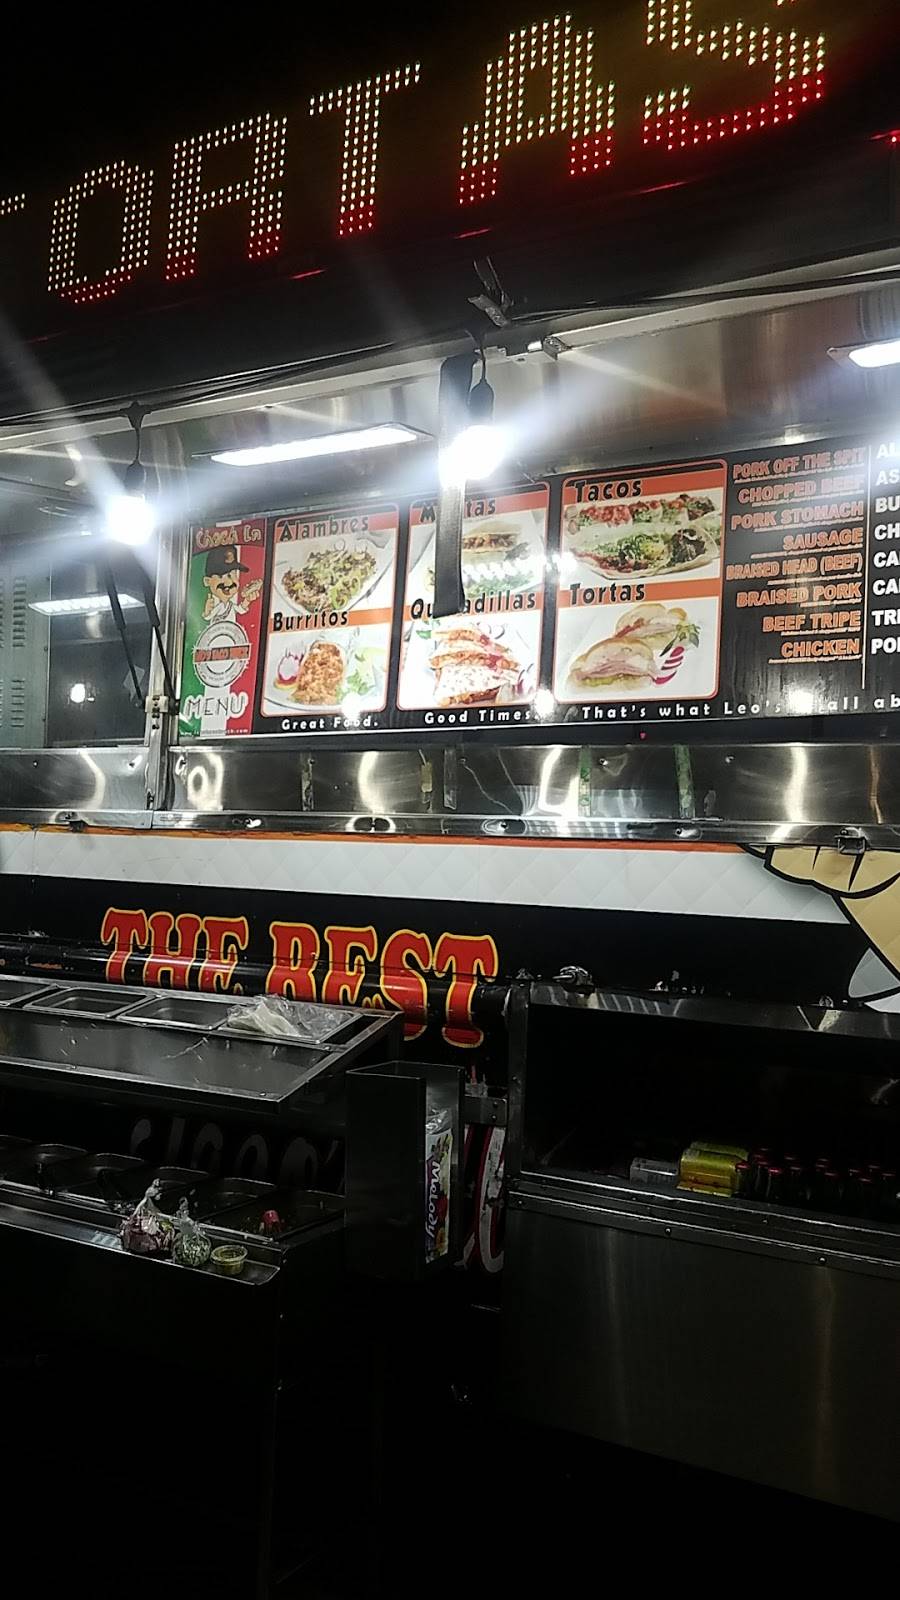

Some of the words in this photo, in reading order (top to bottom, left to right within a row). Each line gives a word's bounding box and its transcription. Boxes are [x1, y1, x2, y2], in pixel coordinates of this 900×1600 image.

[732, 460, 770, 480] PORK
[773, 455, 801, 473] OFF
[803, 451, 831, 470] THE
[833, 446, 866, 466] SPIT
[574, 479, 642, 503] Tacos
[738, 480, 817, 504] CHOPPED
[821, 473, 865, 491] BEEF
[420, 498, 496, 523] Mtas
[731, 510, 778, 530] PORK
[780, 500, 864, 523] STOMACH
[279, 514, 370, 542] Alambres
[782, 527, 863, 551] SAUSAGE
[726, 559, 780, 581] BRAISED
[782, 556, 818, 576] HEAD
[820, 552, 863, 576] (BEEF)
[873, 550, 900, 568] CA
[570, 583, 646, 606] Tortas
[736, 585, 809, 608] BRAISED
[813, 581, 862, 601] PORK
[872, 578, 900, 596] CA
[410, 590, 536, 619] Quadillas
[272, 609, 348, 632] Burritos
[763, 613, 806, 632] BEEF
[810, 610, 861, 629] TRIPE
[780, 637, 860, 659] CHICKEN
[185, 692, 248, 719] MENU
[424, 710, 468, 724] Good
[582, 704, 647, 720] That's
[659, 703, 711, 717] what
[724, 700, 781, 715] Leo's
[827, 696, 859, 710] all
[873, 694, 900, 708] ab
[281, 718, 325, 731] Great
[100, 906, 250, 996] THE
[265, 919, 500, 1049] BEST
